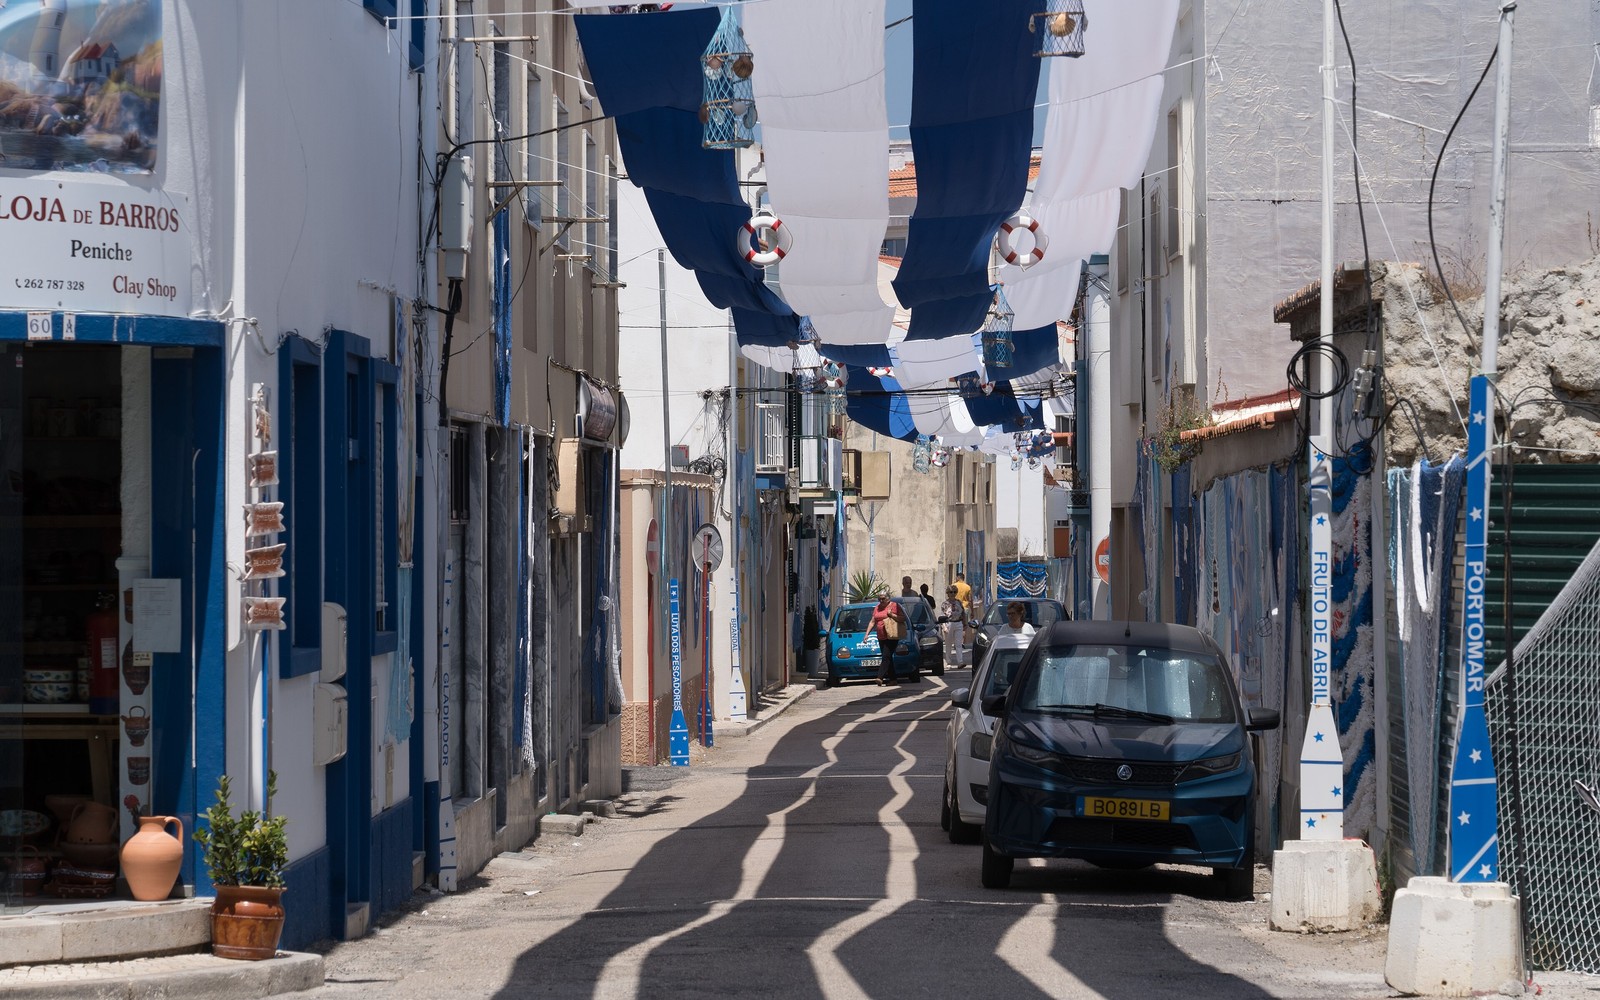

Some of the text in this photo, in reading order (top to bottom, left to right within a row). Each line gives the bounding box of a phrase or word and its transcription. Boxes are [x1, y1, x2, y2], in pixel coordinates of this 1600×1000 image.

[73, 209, 93, 224] DE
[99, 201, 179, 232] BARROS
[70, 240, 133, 261] Peniche
[24, 278, 85, 291] 262 787 328
[112, 275, 177, 301] Clay Shop
[30, 318, 73, 334] 60 A
[730, 618, 738, 652] BRANDAL
[1314, 552, 1328, 703] FRUTO DE ABRIL
[1467, 561, 1484, 693] PORTOMAR
[671, 613, 681, 711] LUTA DOS PESCADORES
[442, 672, 450, 766] GLADIADOR
